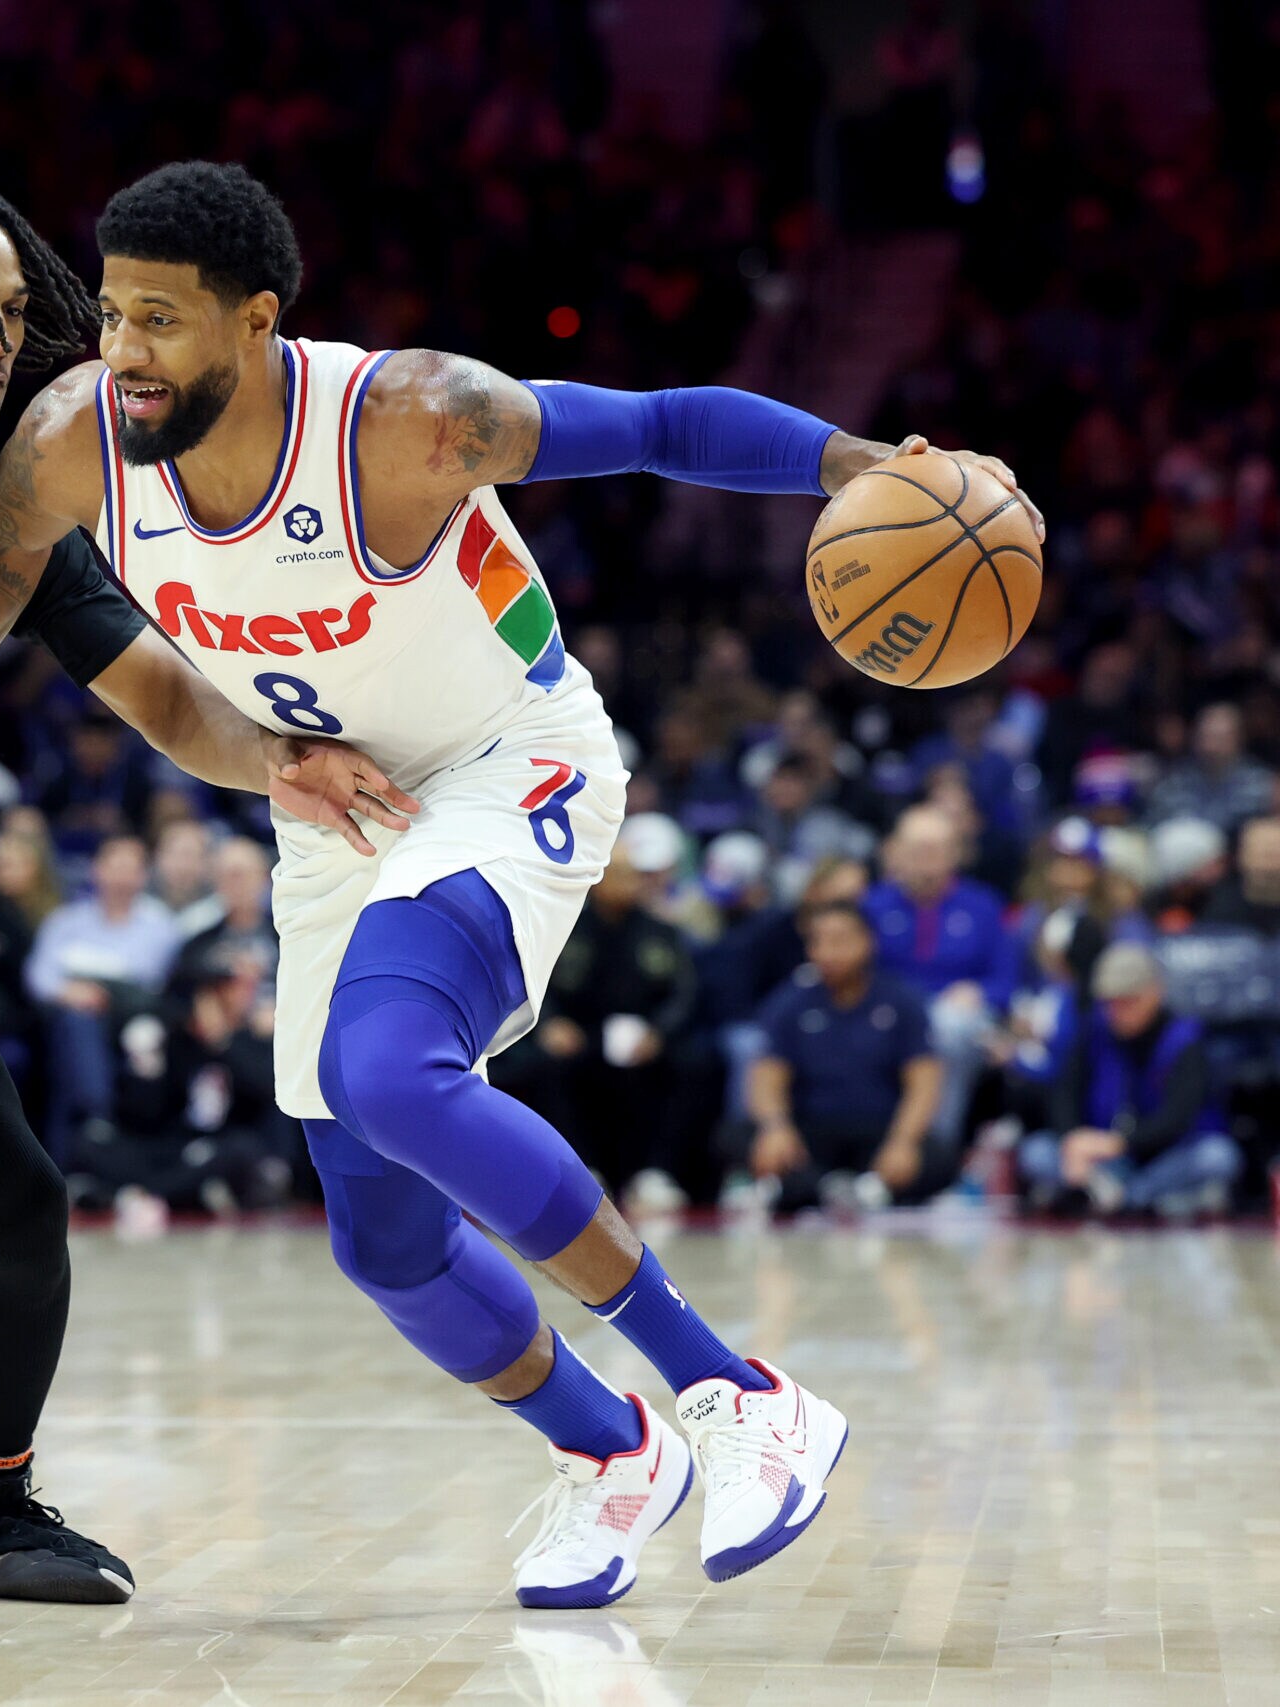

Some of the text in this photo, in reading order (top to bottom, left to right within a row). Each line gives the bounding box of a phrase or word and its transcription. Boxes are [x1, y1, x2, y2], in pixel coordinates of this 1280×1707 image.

[276, 550, 344, 564] crypto.com
[154, 581, 378, 657] Sixers
[253, 672, 343, 735] 8
[518, 758, 587, 864] 76
[693, 1404, 717, 1421] VUK
[697, 1390, 721, 1409] CUT
